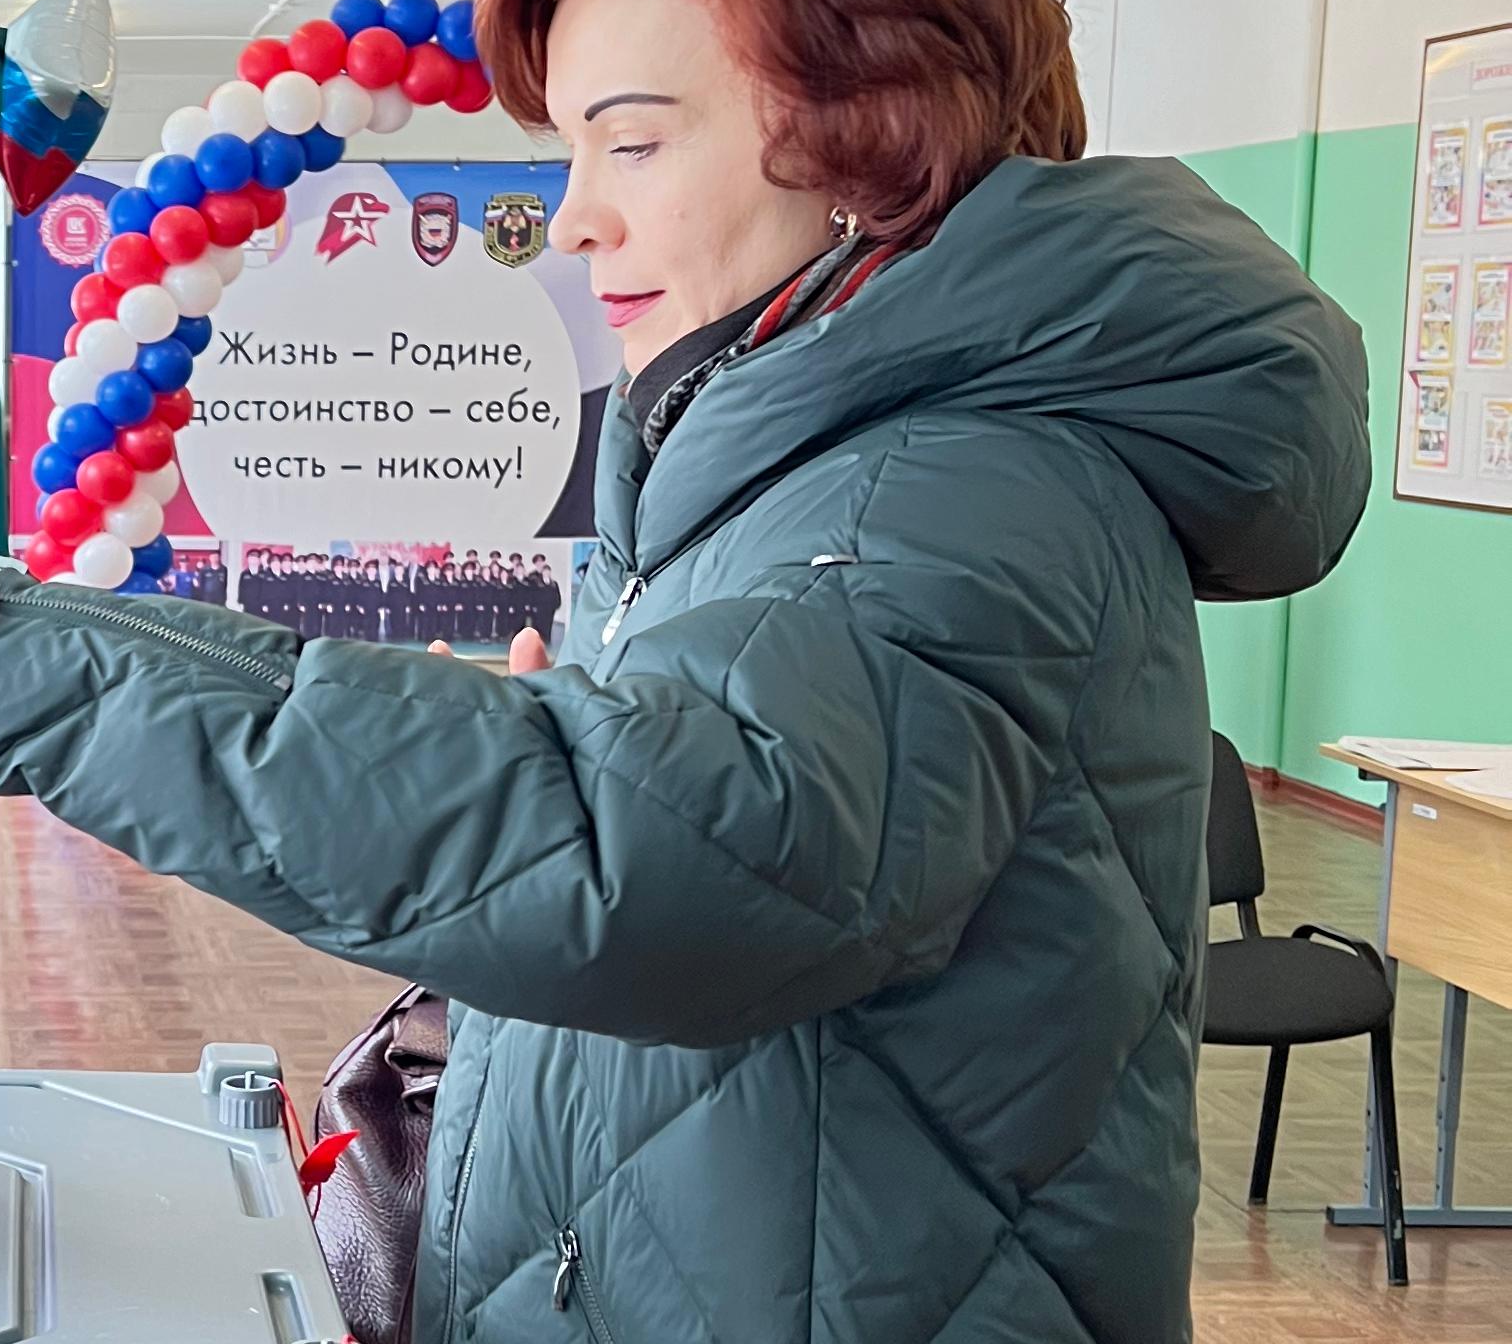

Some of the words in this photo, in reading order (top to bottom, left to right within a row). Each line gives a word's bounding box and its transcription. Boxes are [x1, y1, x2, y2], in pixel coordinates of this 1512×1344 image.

[219, 331, 338, 365] Жизнь
[390, 331, 532, 372] Родине,
[187, 399, 414, 426] достоинство
[466, 387, 560, 430] себе,
[234, 456, 326, 478] честь
[378, 445, 523, 489] никому!
